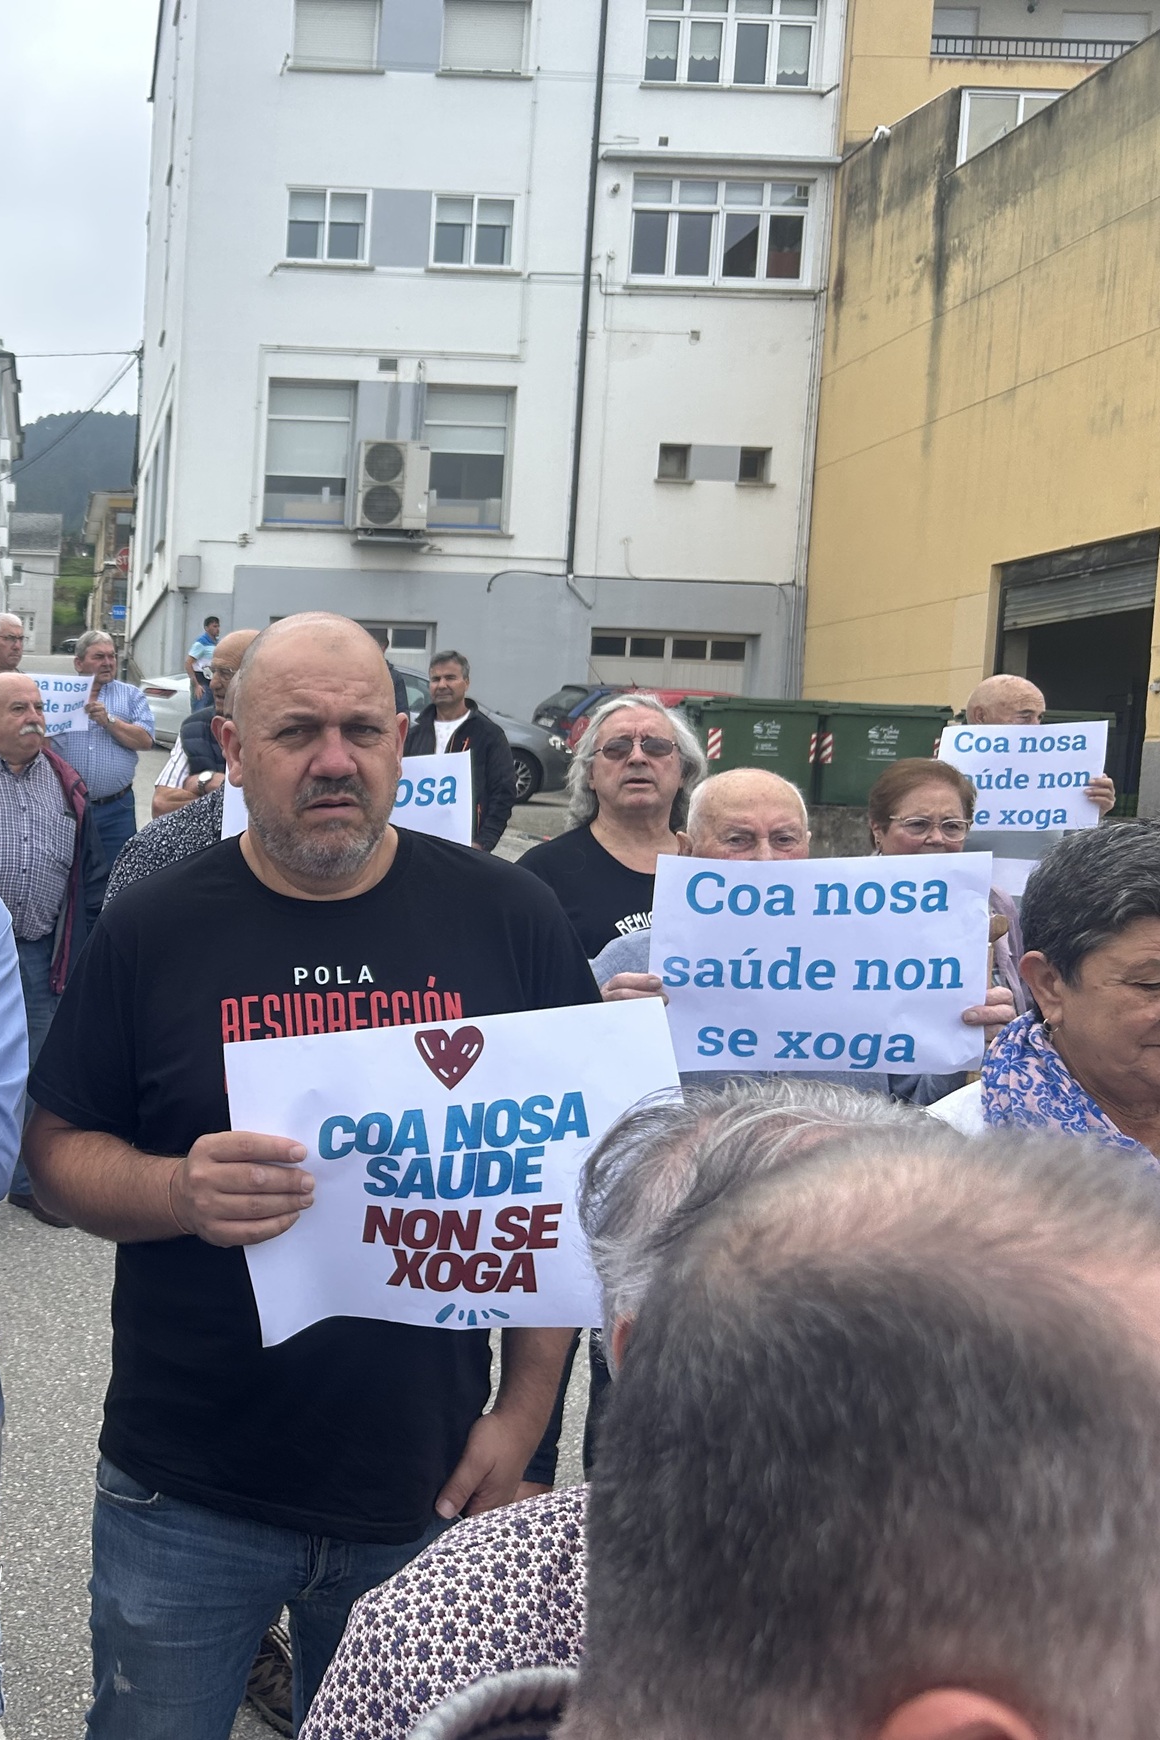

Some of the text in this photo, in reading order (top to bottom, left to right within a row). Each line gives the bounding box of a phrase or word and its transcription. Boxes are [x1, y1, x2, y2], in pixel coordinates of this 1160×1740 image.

[53, 681, 88, 692] nosa
[954, 731, 1087, 753] Coa nosa
[394, 775, 457, 809] osa
[963, 767, 1090, 790] úde non
[974, 807, 1068, 830] e xoga
[685, 871, 949, 917] Coa nosa
[293, 965, 374, 986] POLA
[662, 946, 964, 991] saúde non
[697, 1026, 915, 1070] se xoga
[318, 1091, 590, 1160] COA NOSA
[362, 1203, 563, 1250] NON SE
[385, 1249, 538, 1293] XOGA
